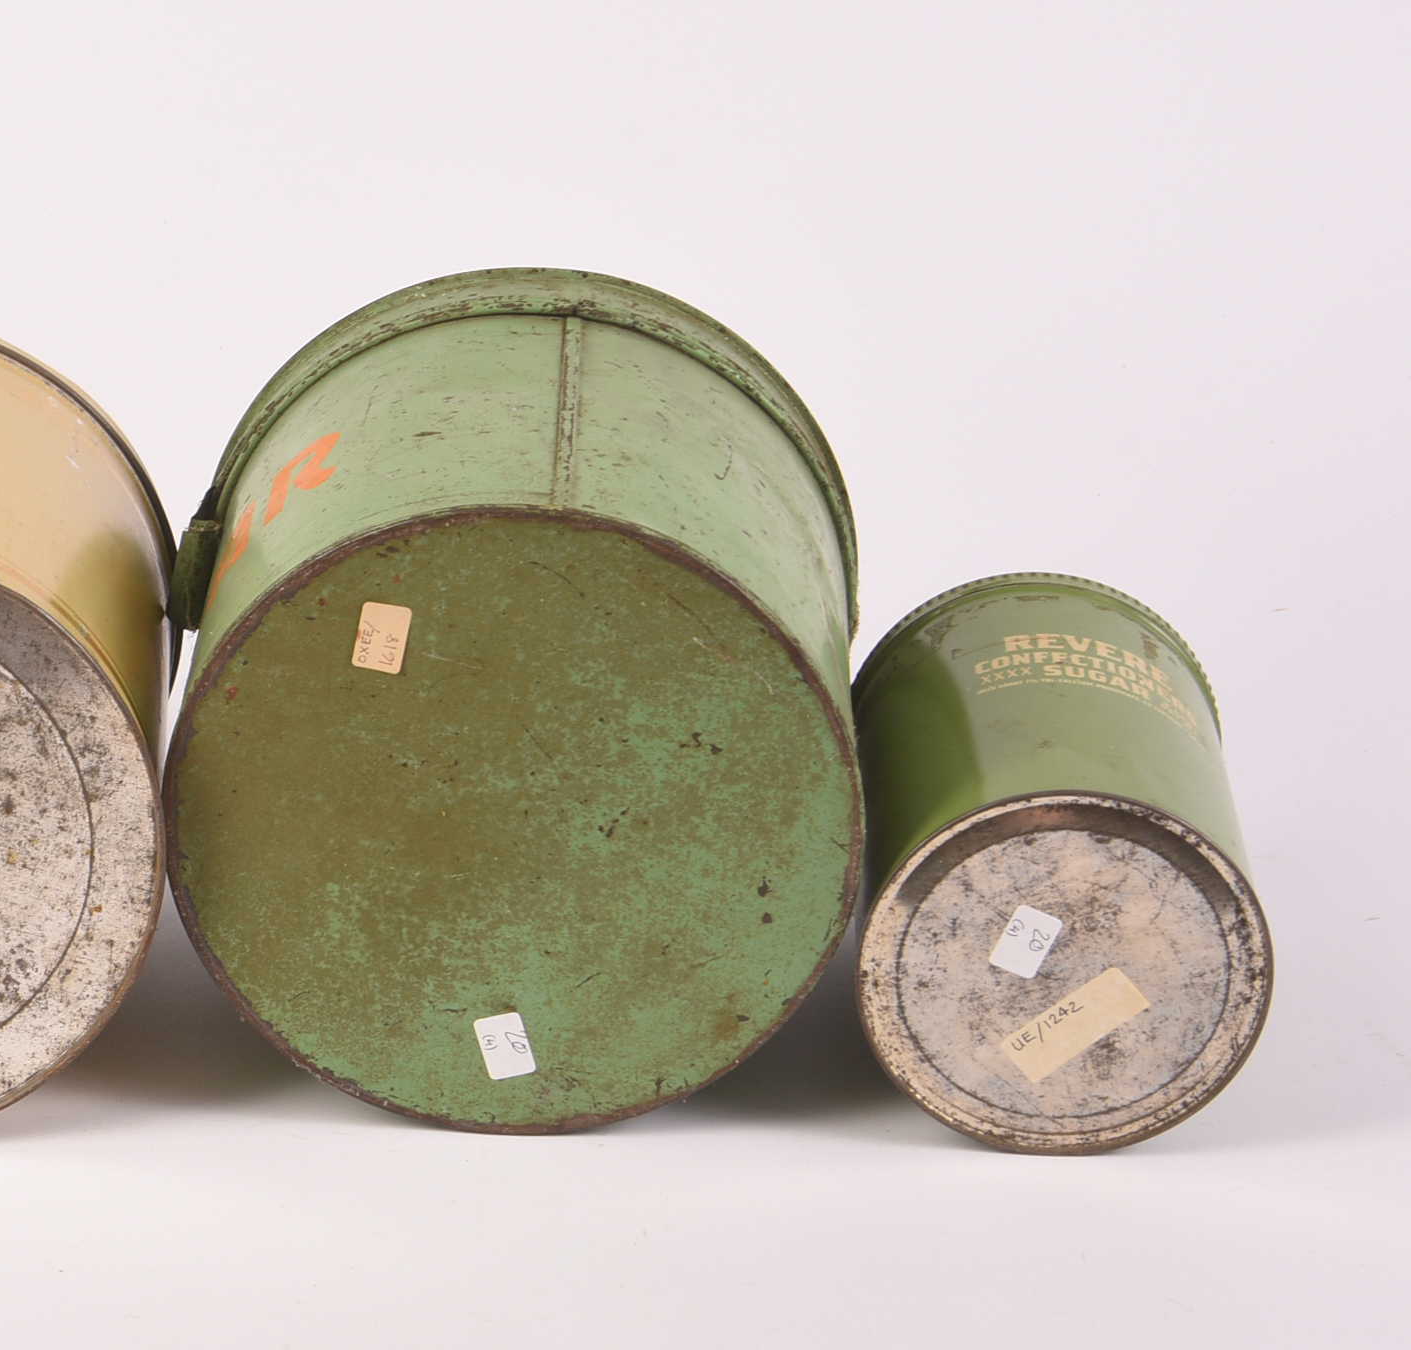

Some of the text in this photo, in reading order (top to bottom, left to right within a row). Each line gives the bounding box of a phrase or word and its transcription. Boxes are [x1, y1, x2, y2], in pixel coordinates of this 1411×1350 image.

[378, 633, 399, 666] 1618
[1003, 633, 1173, 692] REVERE
[1043, 664, 1150, 701] SUGAR
[1028, 928, 1050, 952] 20
[1010, 1001, 1085, 1051] UE/1242
